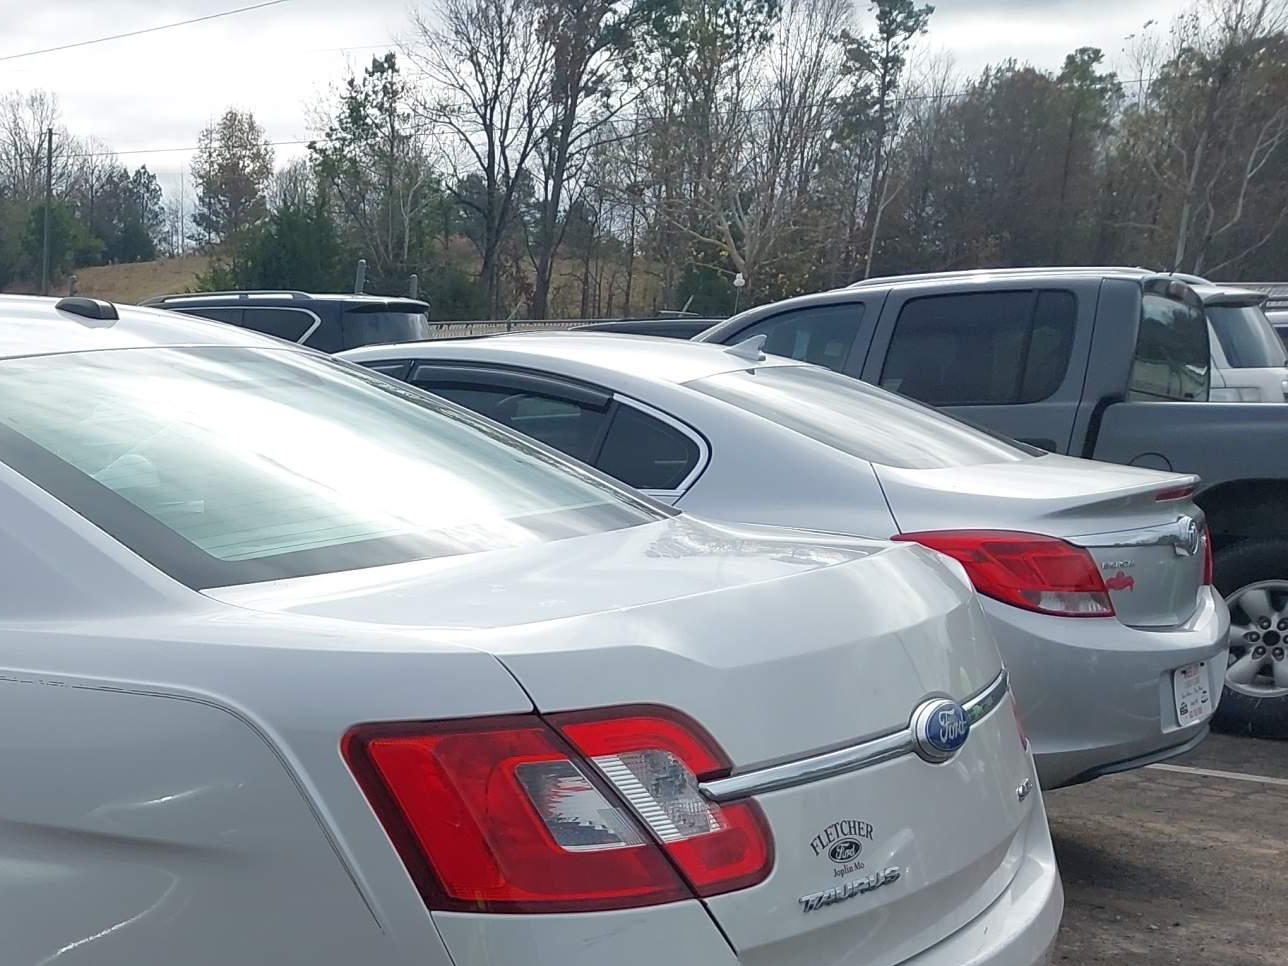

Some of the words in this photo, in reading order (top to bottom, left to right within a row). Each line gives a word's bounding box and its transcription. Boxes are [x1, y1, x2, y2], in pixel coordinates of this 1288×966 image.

[938, 708, 967, 743] Ford
[810, 819, 874, 856] FLETCHER
[799, 866, 901, 912] TAURUS
[833, 864, 854, 878] Joplin
